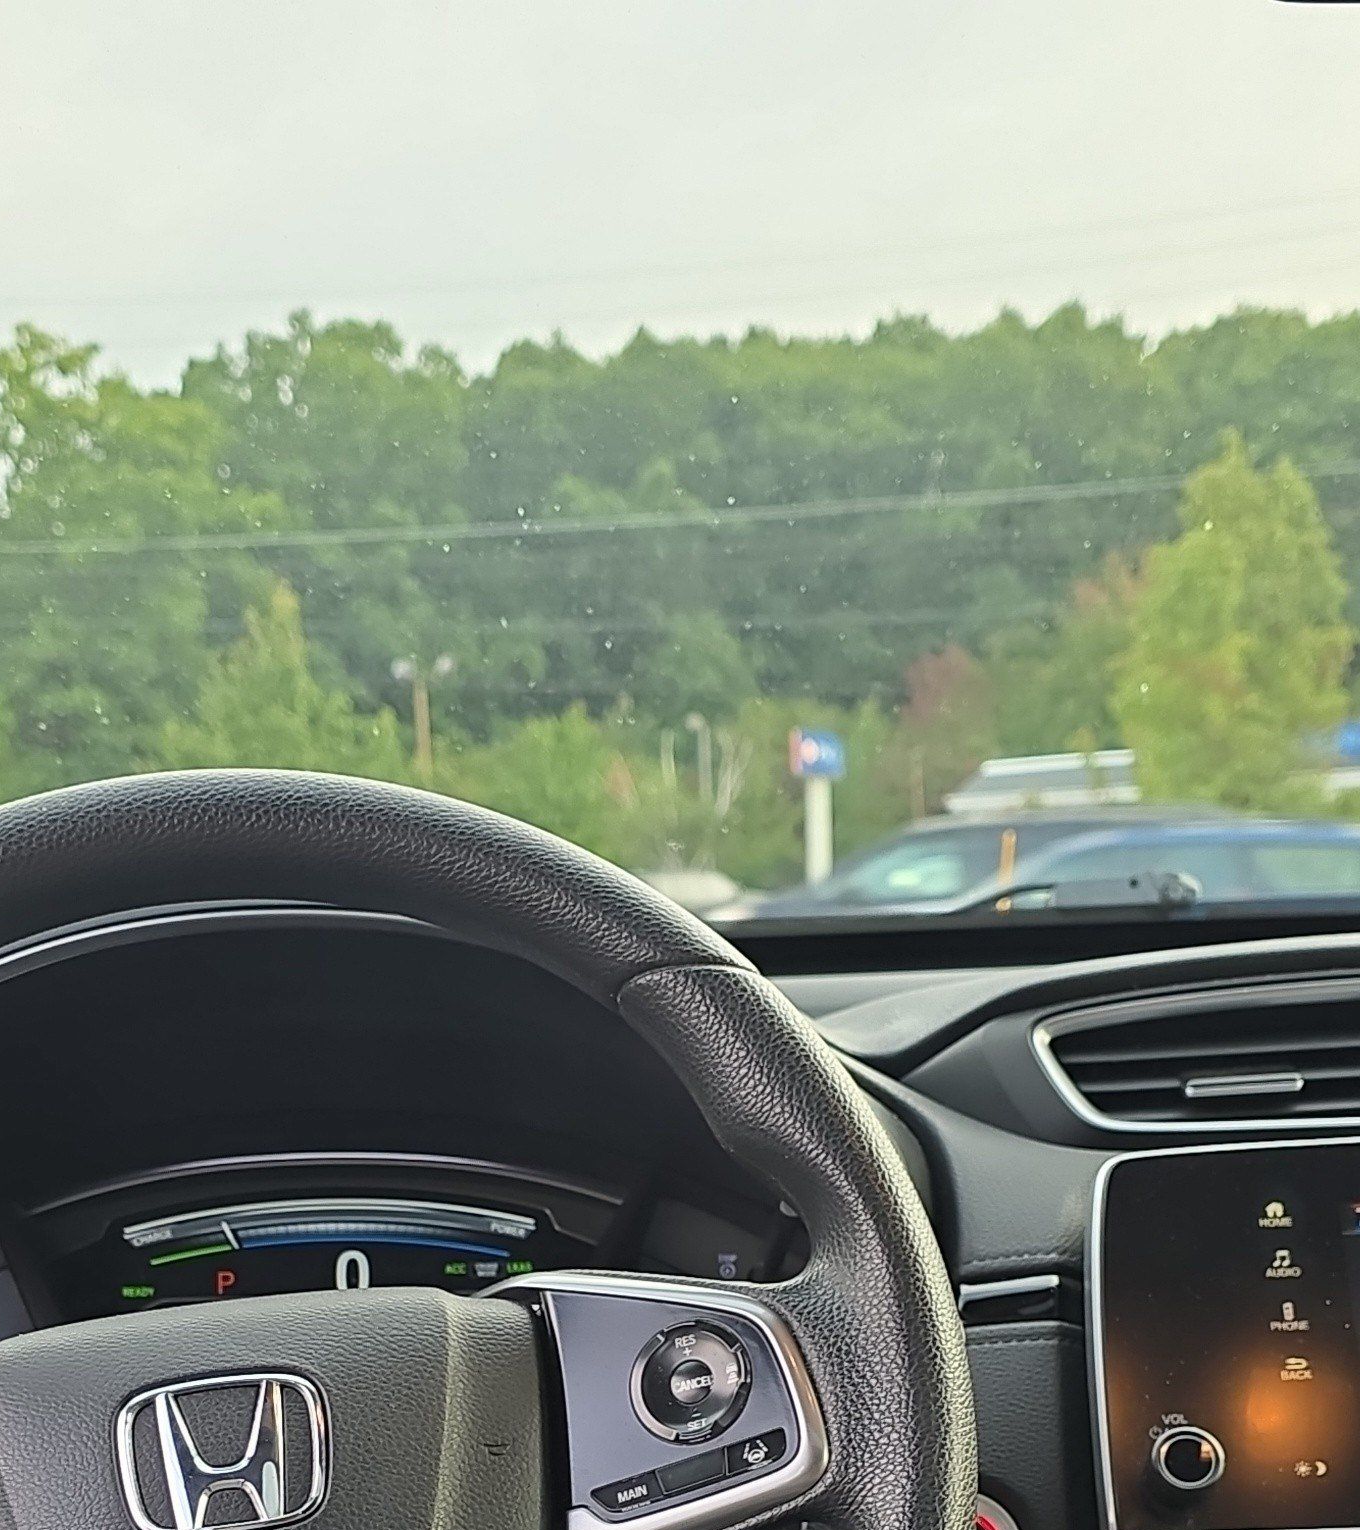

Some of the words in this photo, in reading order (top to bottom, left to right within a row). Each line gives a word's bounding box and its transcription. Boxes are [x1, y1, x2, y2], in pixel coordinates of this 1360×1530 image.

[1258, 1216, 1292, 1228] HOME
[336, 1249, 370, 1290] 0
[1265, 1266, 1303, 1278] AUDIO
[217, 1270, 236, 1295] P
[1269, 1319, 1310, 1332] PHONE
[674, 1334, 696, 1350] RES
[1280, 1369, 1314, 1381] BACK
[673, 1374, 715, 1395] CANCEL
[686, 1418, 708, 1431] SET
[1161, 1413, 1188, 1425] VOL
[617, 1484, 649, 1504] MAIN
